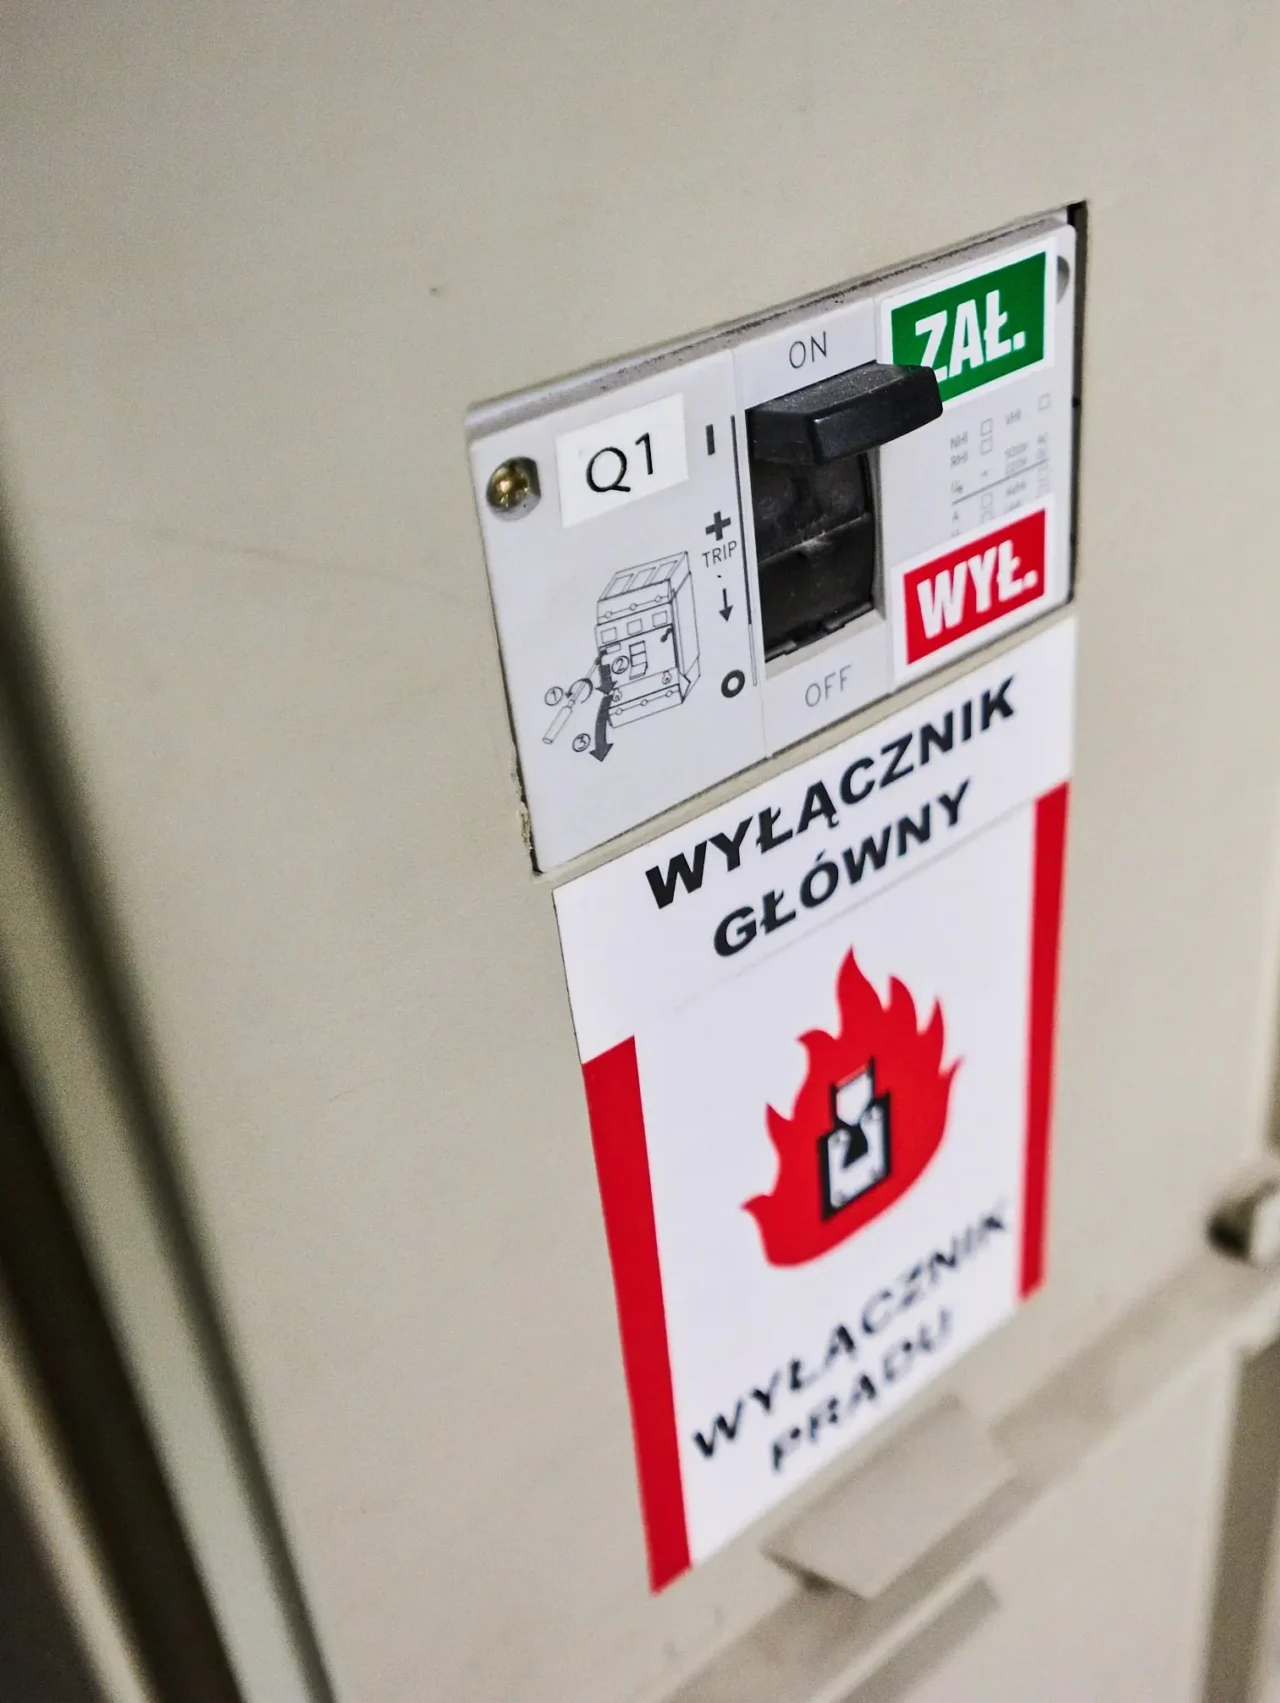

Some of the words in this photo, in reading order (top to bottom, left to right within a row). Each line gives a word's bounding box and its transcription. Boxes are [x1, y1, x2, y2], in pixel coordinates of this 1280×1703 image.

[789, 331, 827, 369] ON
[915, 290, 1026, 383] ZAŁ.
[586, 432, 653, 492] Q1
[702, 540, 737, 568] TRIP
[917, 540, 1038, 639] WYŁ.
[805, 664, 852, 707] OFF
[645, 676, 1015, 909] WYŁĄCZNIK
[713, 779, 971, 957] GŁÓWNY
